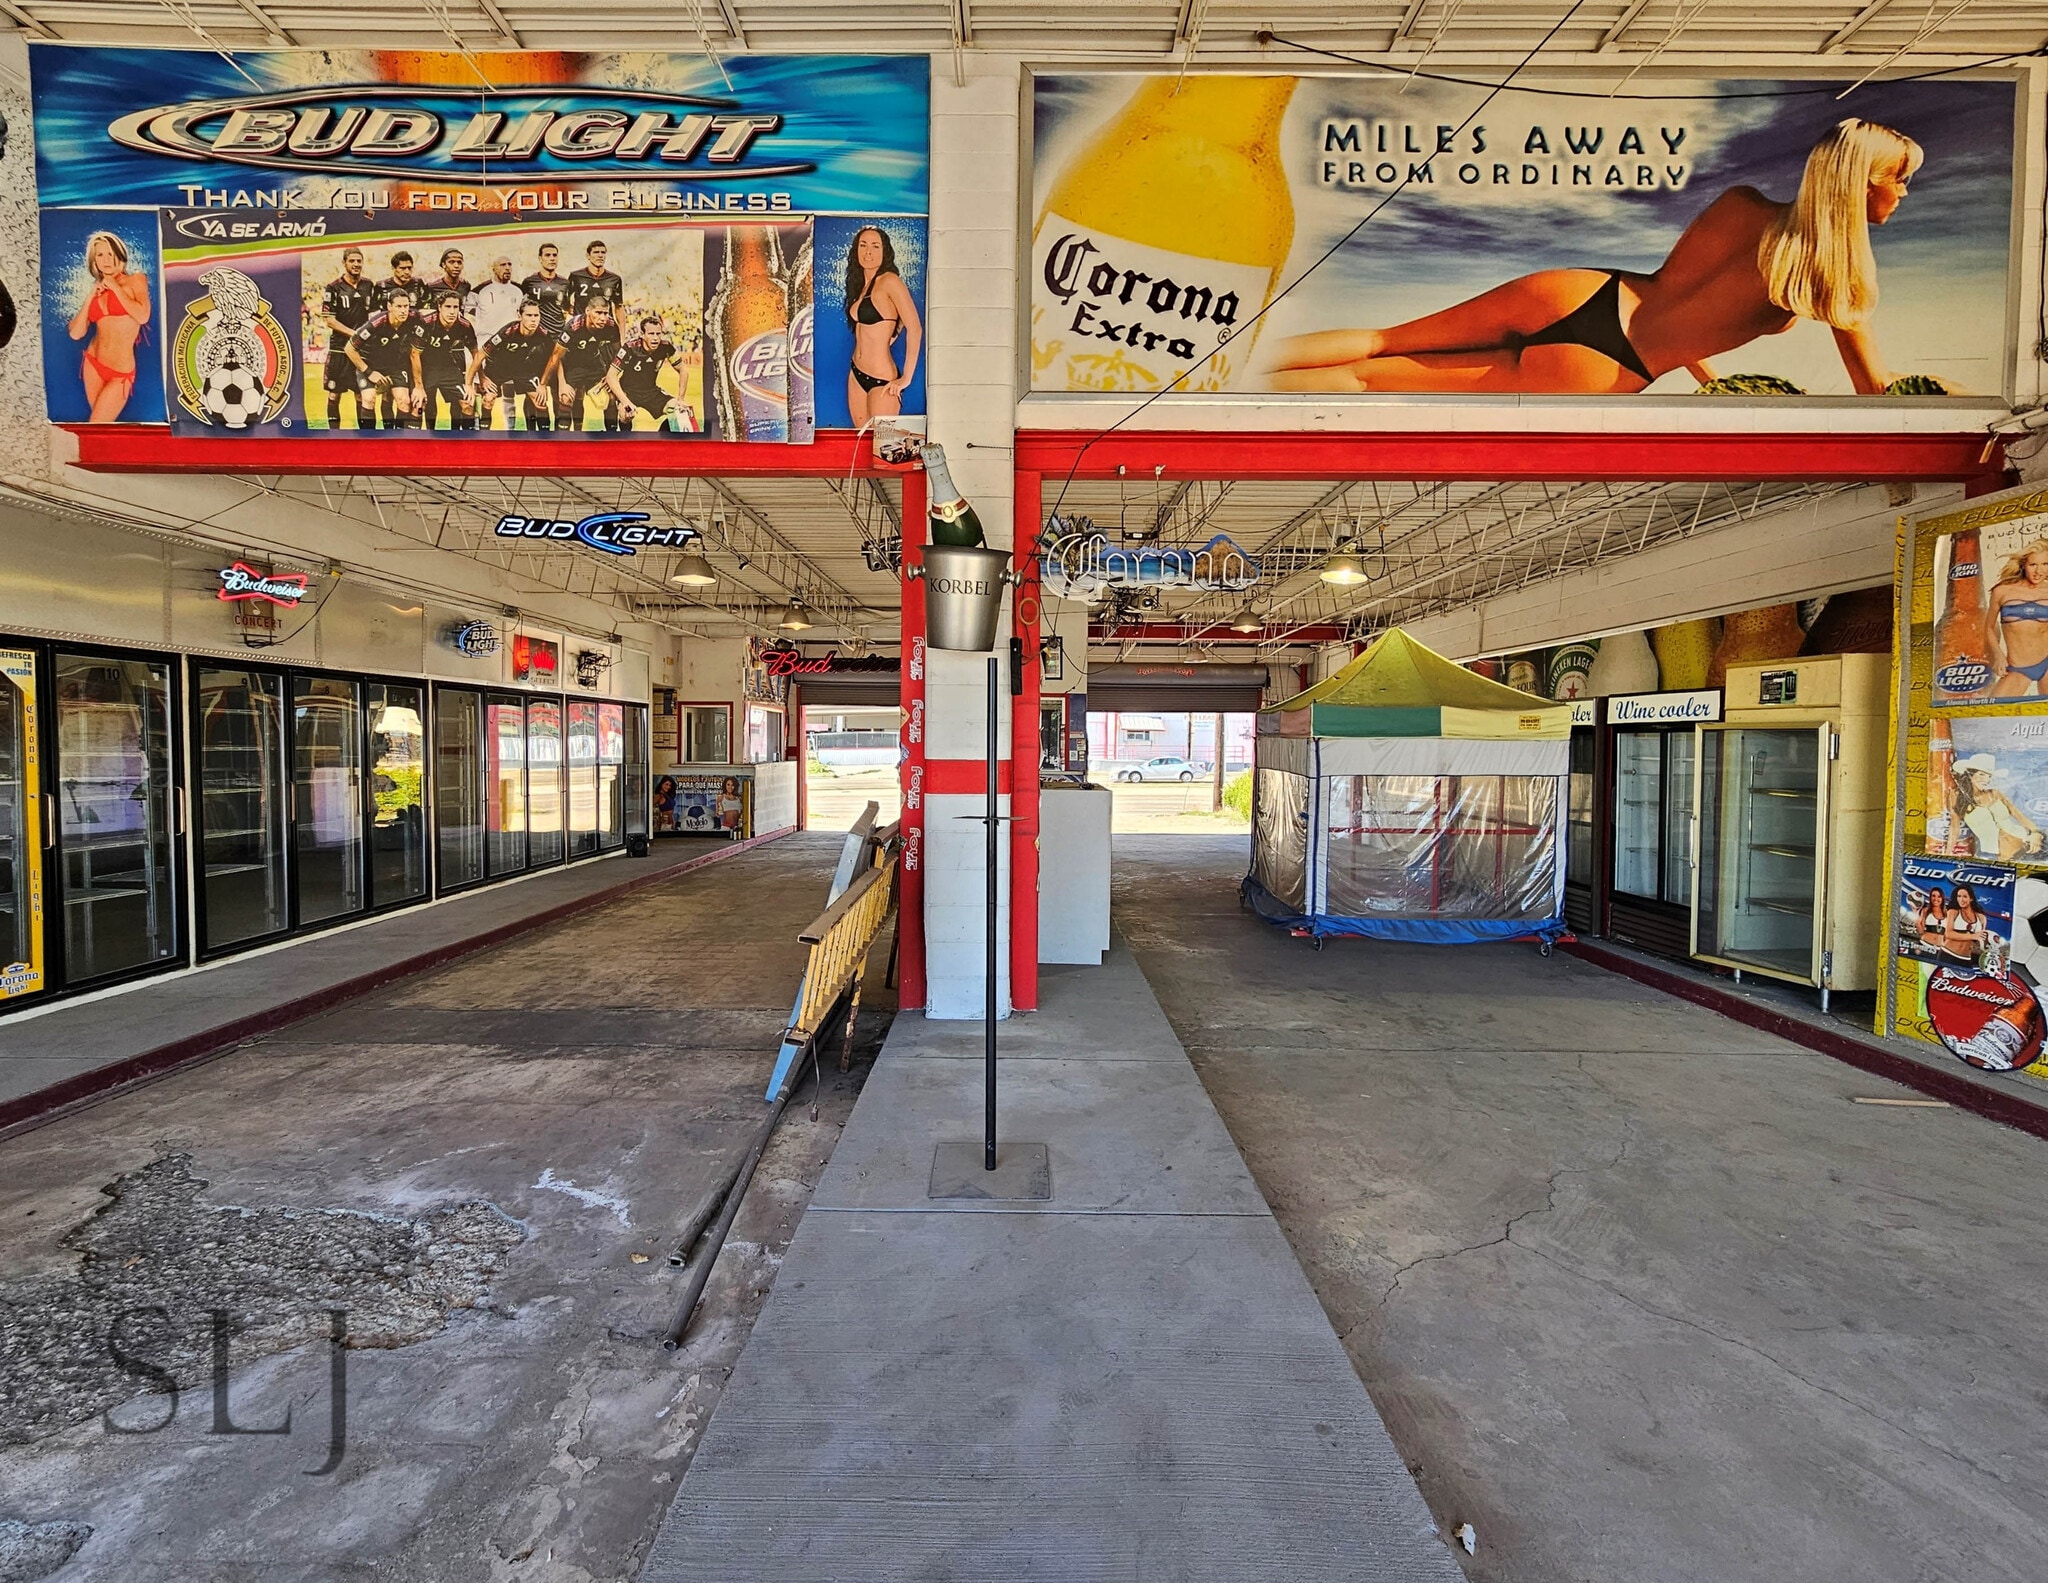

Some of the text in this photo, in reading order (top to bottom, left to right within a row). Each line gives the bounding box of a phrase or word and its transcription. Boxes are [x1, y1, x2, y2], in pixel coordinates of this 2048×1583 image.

[211, 108, 779, 163] BUD LIGHT
[1324, 123, 1688, 156] MILES AWAY
[1323, 160, 1689, 187] FROM ORDINARY
[178, 184, 304, 210] THANK
[326, 186, 391, 210] YOU
[408, 190, 479, 211] FOR
[493, 188, 590, 211] YOUR
[608, 189, 793, 212] BUSINESS
[200, 216, 327, 238] YA SE ARMÓ
[579, 283, 588, 297] 2
[1043, 233, 1240, 327] Corona
[532, 287, 542, 301] 4
[262, 318, 272, 328] DE
[270, 327, 287, 354] FUTBOL
[1069, 301, 1197, 360] Extra
[380, 337, 389, 347] 9
[430, 336, 442, 348] 16
[177, 320, 199, 400] FEDERACION MEXICANA
[633, 360, 642, 372] 6
[496, 517, 695, 545] BUD LIGHT
[1047, 532, 1245, 600] Corona
[1954, 563, 1977, 572] BUD
[219, 567, 308, 599] Budweiser
[928, 577, 992, 596] KORBEL
[234, 613, 283, 630] CONCERT
[466, 639, 498, 652] LIGHT
[471, 630, 494, 640] BUD
[106, 668, 120, 681] 10
[760, 650, 837, 677] Bud
[1945, 664, 1986, 677] BUD
[1938, 674, 1990, 687] LIGHT
[1615, 696, 1711, 720] Wine cooler
[26, 703, 36, 764] Corona
[2011, 721, 2046, 739] Aquí
[1903, 865, 2013, 888] BUD LIGHT
[32, 869, 40, 922] Light
[8, 984, 28, 995] Light
[1930, 976, 2016, 1006] Budweiser
[1959, 1045, 1988, 1058] American
